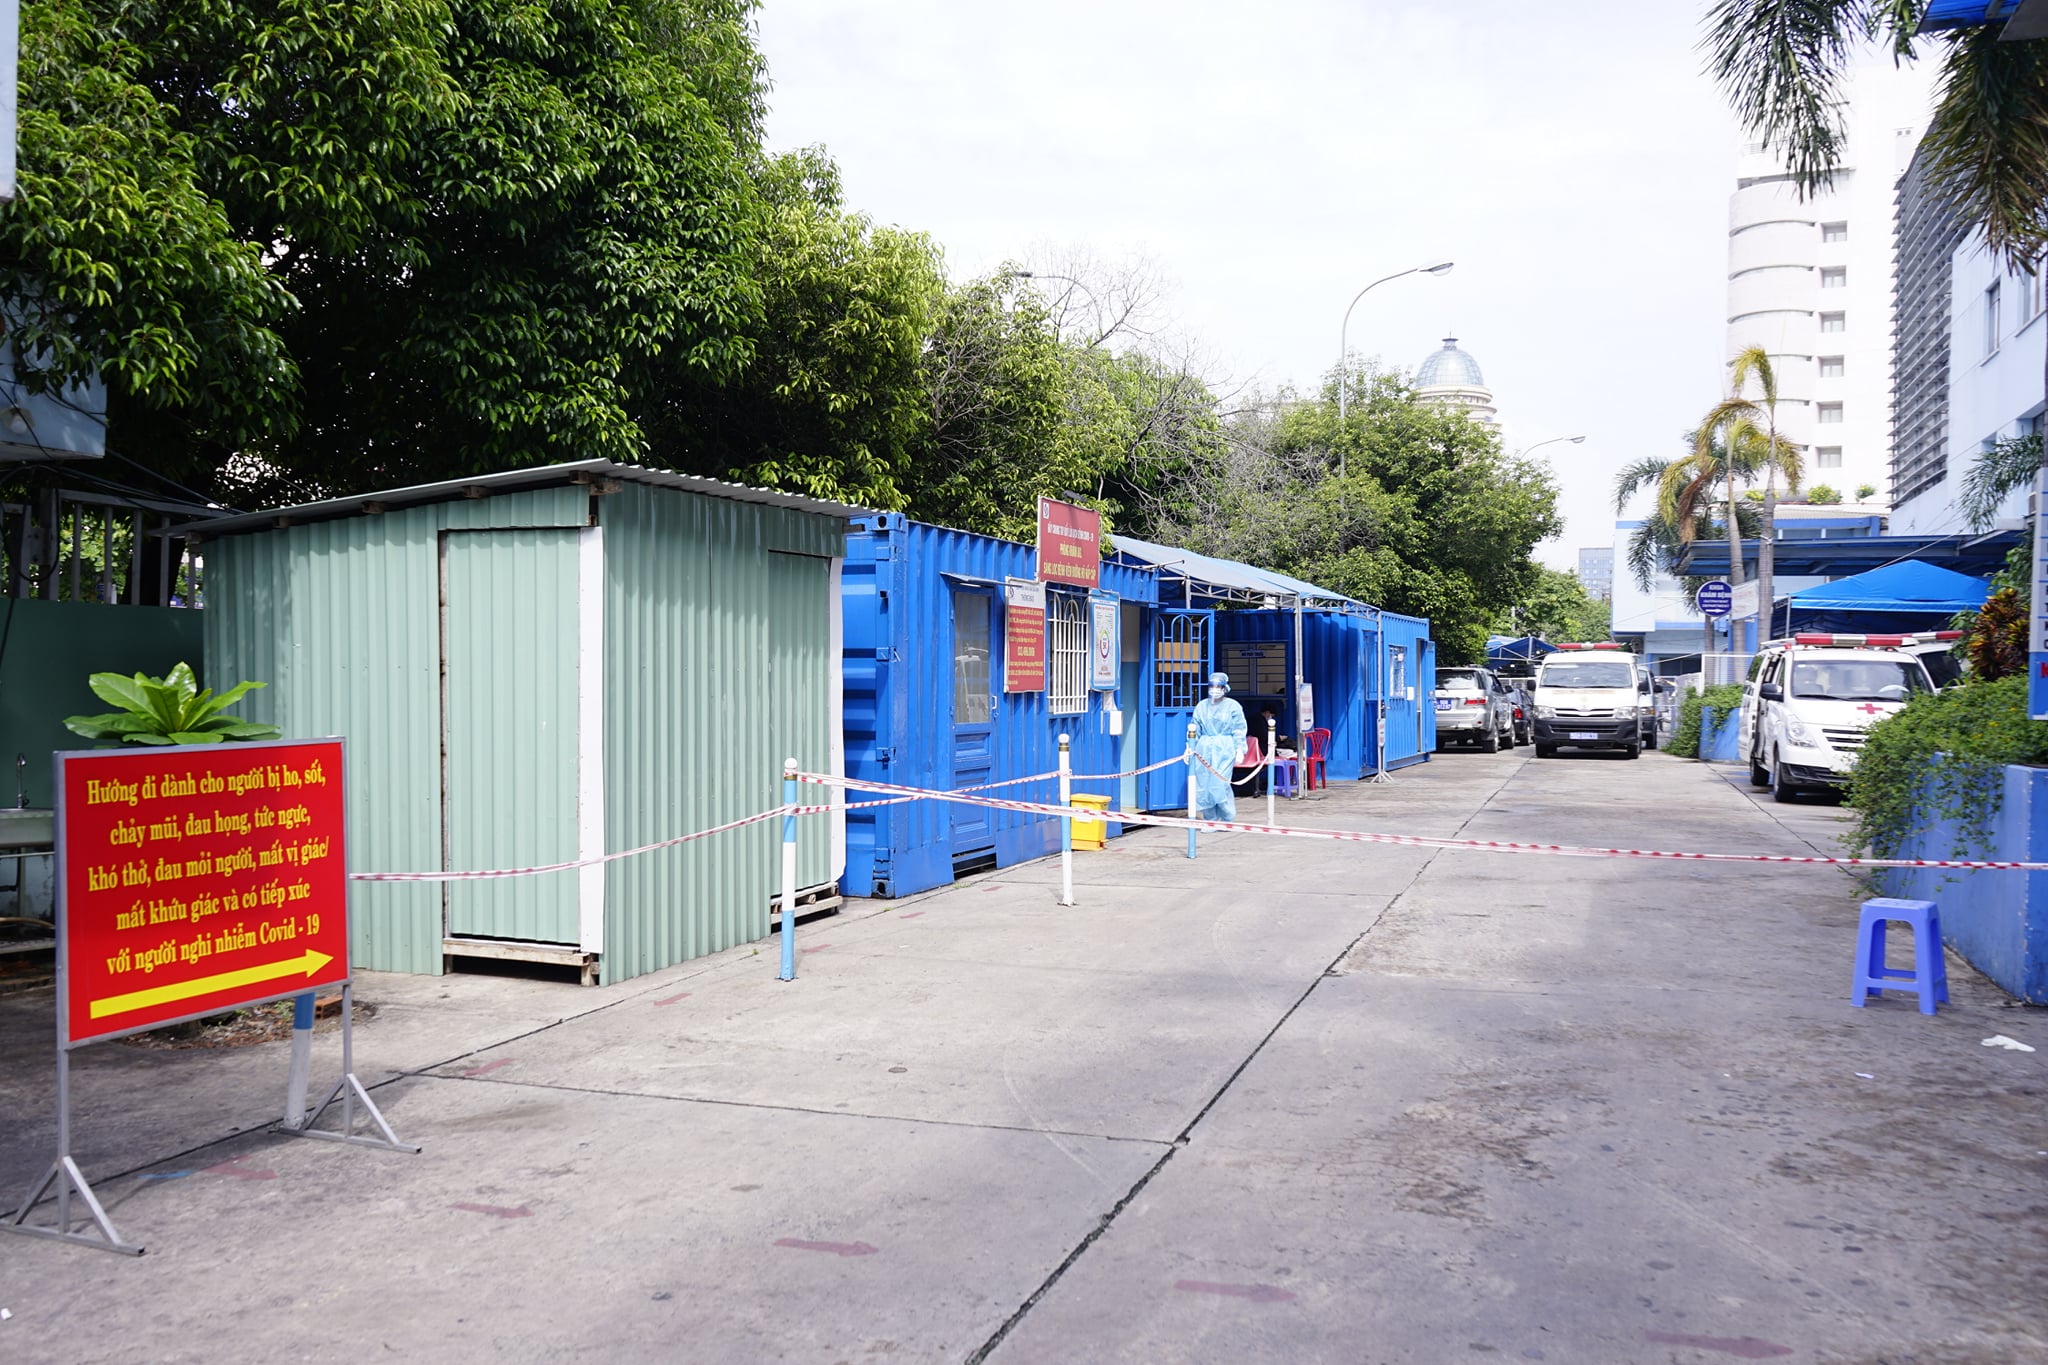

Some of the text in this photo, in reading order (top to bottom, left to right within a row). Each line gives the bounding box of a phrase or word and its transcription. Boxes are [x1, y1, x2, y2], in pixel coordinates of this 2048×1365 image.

[87, 758, 326, 806] Hướng đi dành cho người bị ho, sốt,
[110, 803, 311, 848] chảy mũi, đau họng, tức ngực,
[88, 835, 330, 892] khó thở, đau mỏi người, mất vị giác/
[116, 877, 311, 930] mất khứu giác và có tiếp xúc
[107, 947, 132, 975] với
[134, 939, 177, 973] người
[180, 932, 212, 964] nghi
[215, 922, 257, 949] nhiễm
[259, 916, 296, 945] Covid
[306, 913, 320, 936] 19
